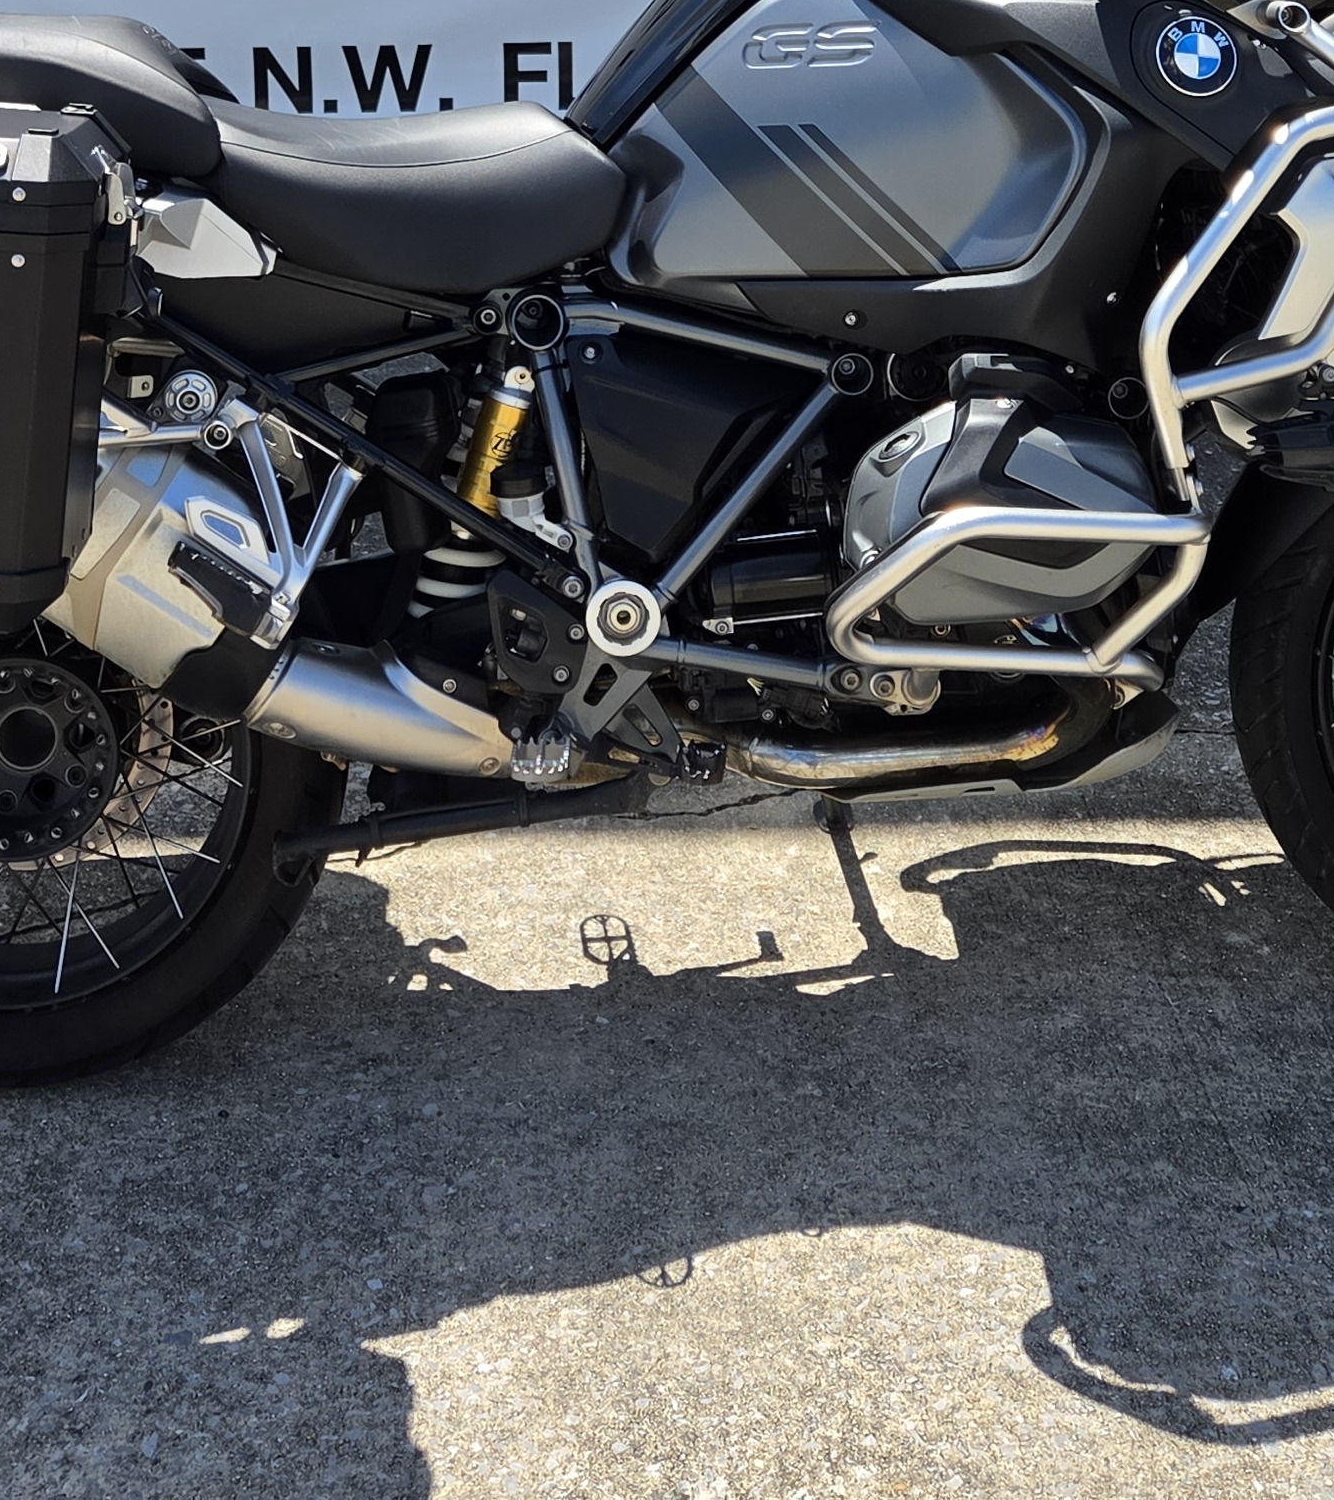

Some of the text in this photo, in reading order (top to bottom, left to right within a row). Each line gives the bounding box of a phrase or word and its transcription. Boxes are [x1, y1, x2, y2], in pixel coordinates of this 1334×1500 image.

[742, 20, 880, 70] GS
[1167, 20, 1229, 48] BMW
[252, 44, 455, 114] N.W.
